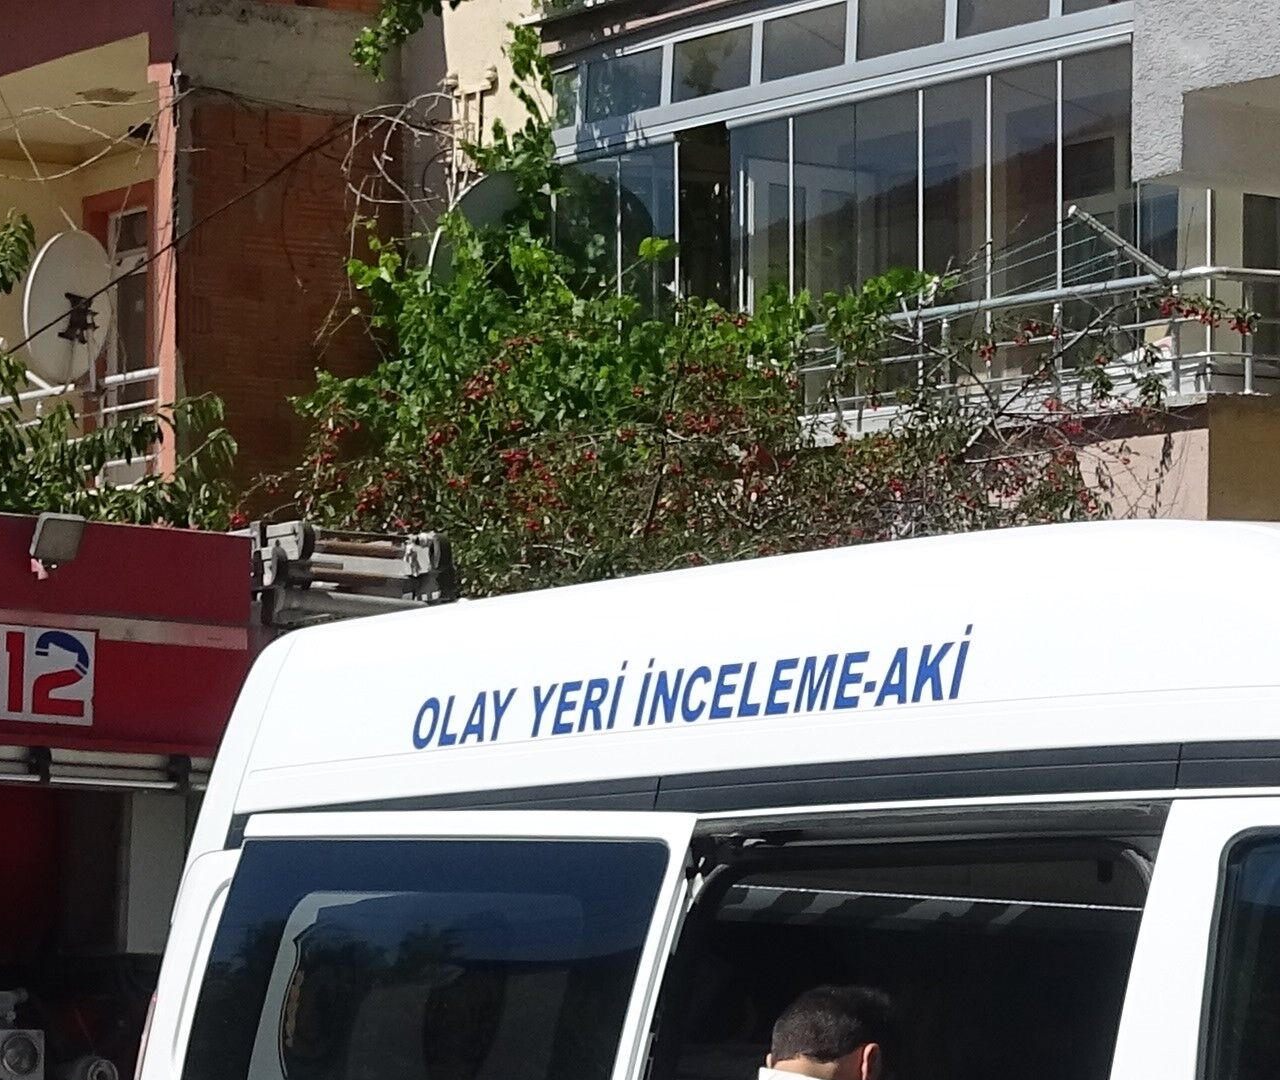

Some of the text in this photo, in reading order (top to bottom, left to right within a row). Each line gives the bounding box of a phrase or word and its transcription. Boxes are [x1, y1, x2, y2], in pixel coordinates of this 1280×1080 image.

[412, 623, 974, 750] OLAY YERİ İNCELEME-AKİ
